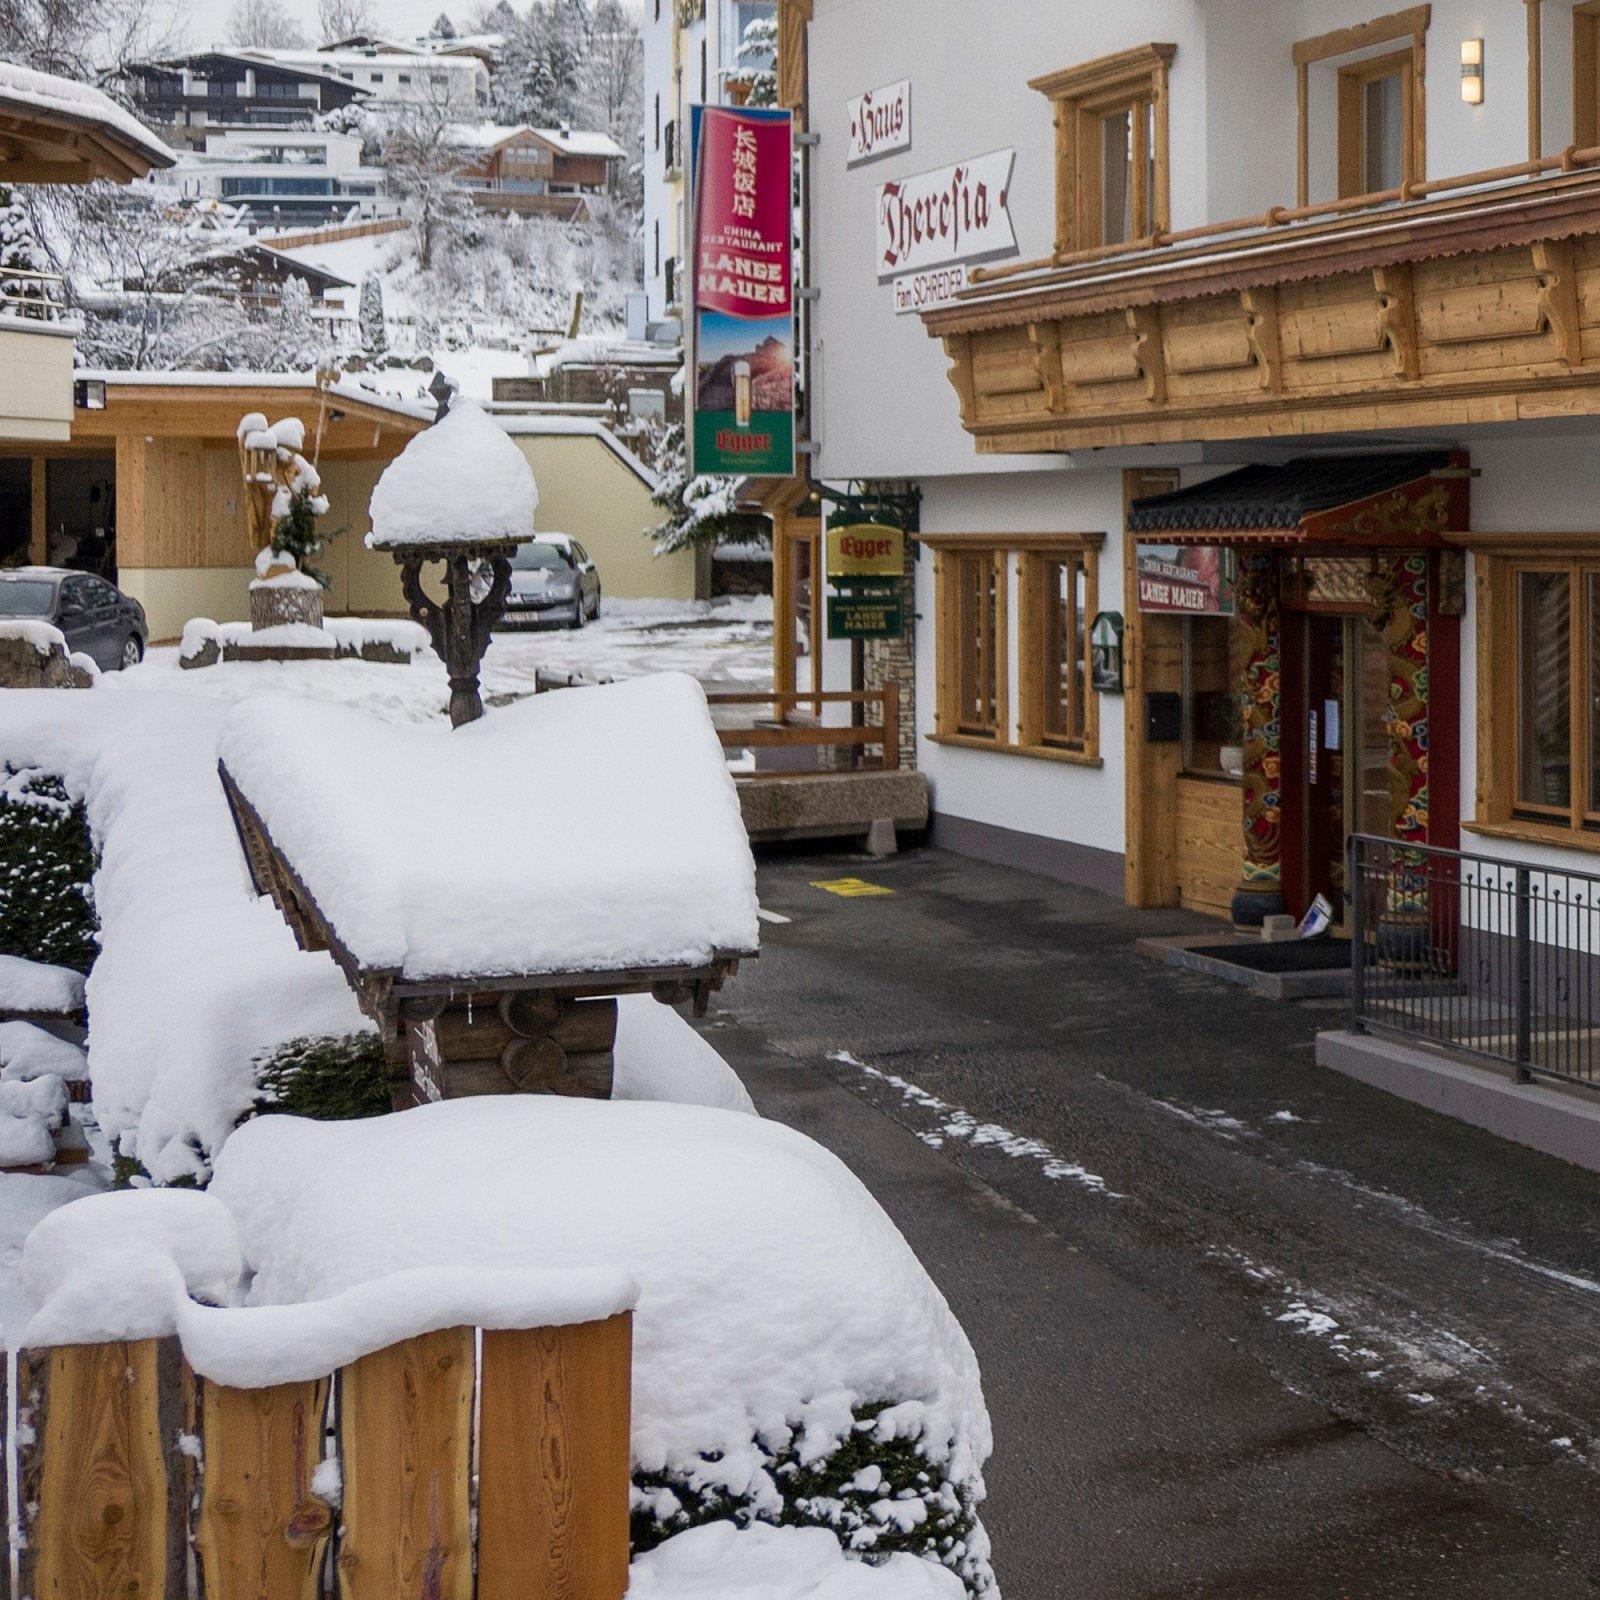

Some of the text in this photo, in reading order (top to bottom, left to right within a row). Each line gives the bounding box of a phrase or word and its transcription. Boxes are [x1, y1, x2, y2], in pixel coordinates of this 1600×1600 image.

[731, 124, 757, 219] 长城饭店
[702, 232, 783, 253] RESTAURANT
[723, 224, 761, 241] CHINA
[701, 252, 783, 282] LANGE
[698, 273, 786, 305] MAUER
[716, 429, 772, 455] Egger
[840, 535, 893, 558] Egger
[1171, 585, 1205, 610] MAUER
